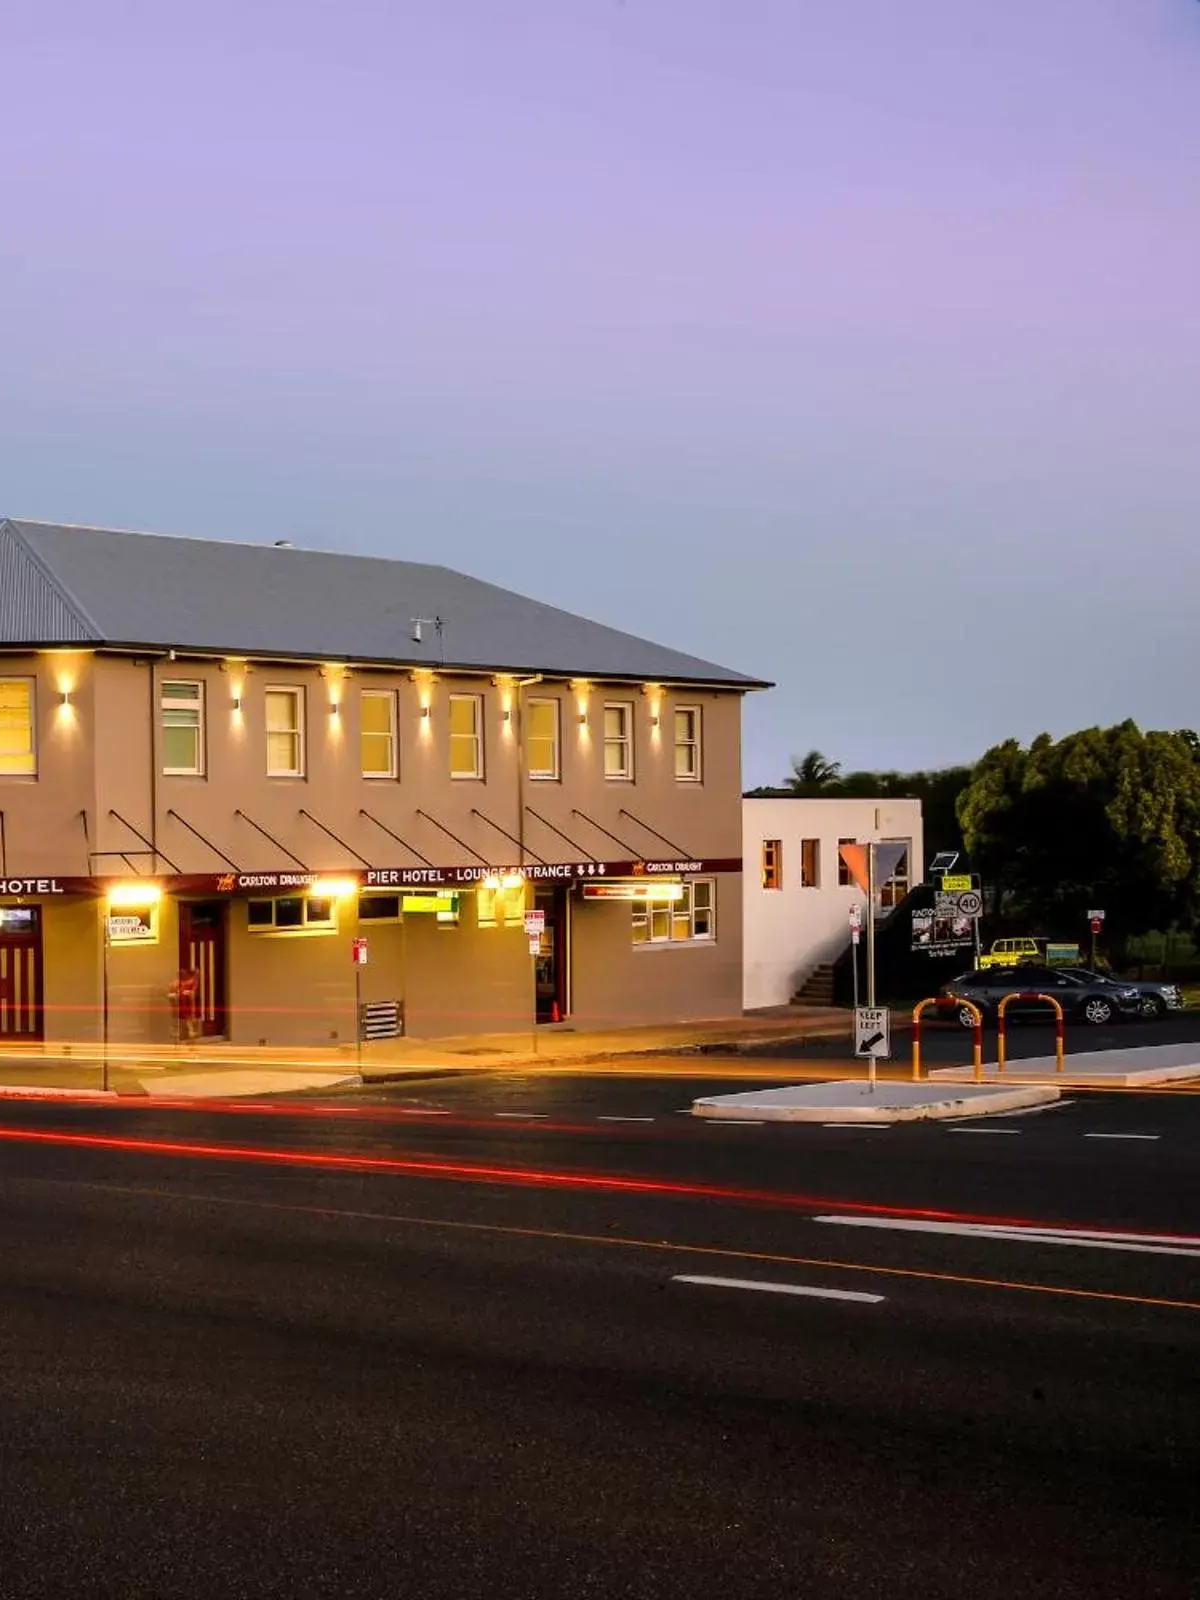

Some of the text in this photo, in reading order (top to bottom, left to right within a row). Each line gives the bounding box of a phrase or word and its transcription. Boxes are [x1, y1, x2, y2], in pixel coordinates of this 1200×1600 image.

[367, 871, 399, 884] PIER
[402, 870, 445, 882] HOTEL
[456, 866, 506, 881] LOUNGE
[511, 865, 572, 879] ENTRANCE
[239, 876, 278, 887] CARLTON
[961, 899, 977, 909] 40
[860, 1011, 883, 1020] KEEP
[860, 1021, 881, 1029] LEFT
